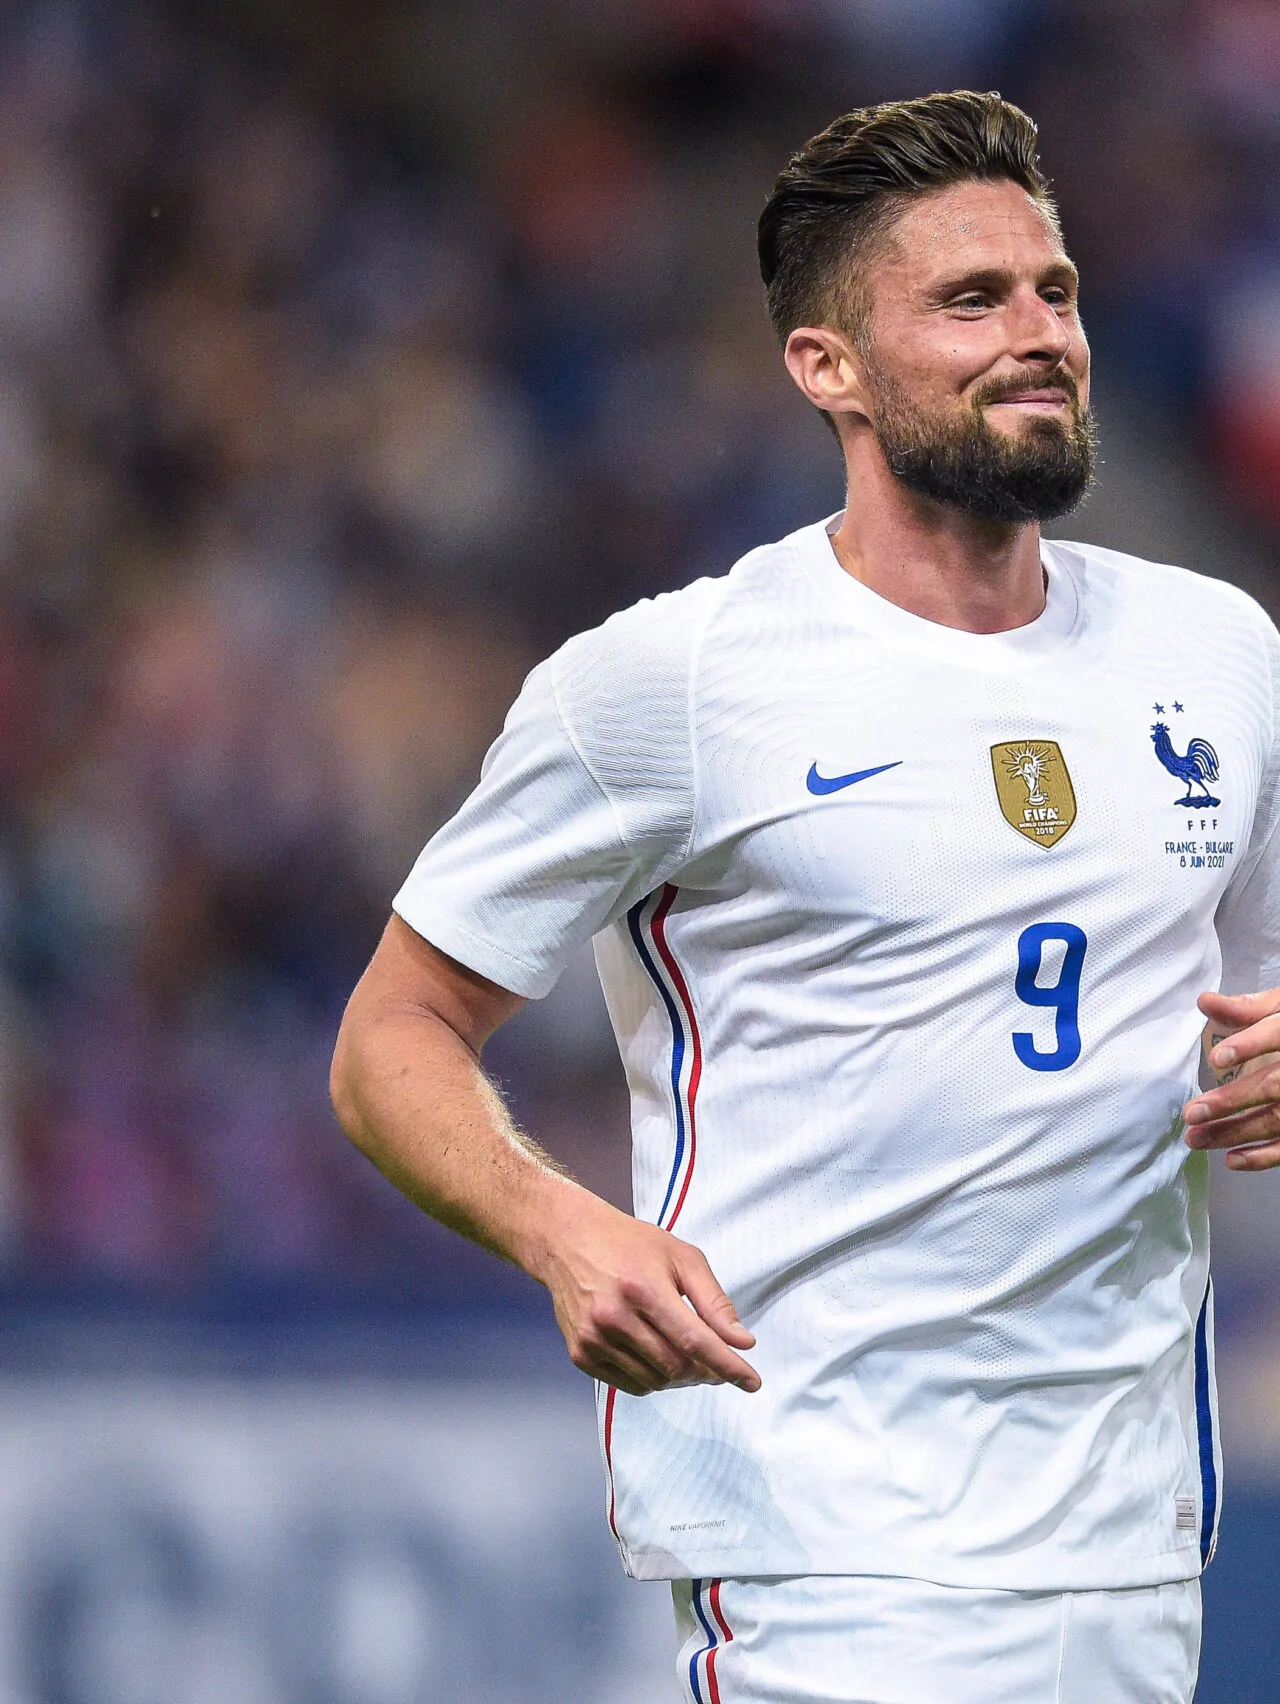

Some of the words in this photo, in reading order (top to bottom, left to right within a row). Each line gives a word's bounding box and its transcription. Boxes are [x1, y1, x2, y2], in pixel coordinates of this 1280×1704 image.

[1023, 807, 1058, 822] FIFA
[1035, 826, 1055, 836] 2018
[1165, 841, 1197, 854] FRANCE
[1180, 855, 1187, 868] 8
[1207, 855, 1225, 868] 2021
[1012, 922, 1088, 1072] 9
[670, 1523, 688, 1532] NIKE
